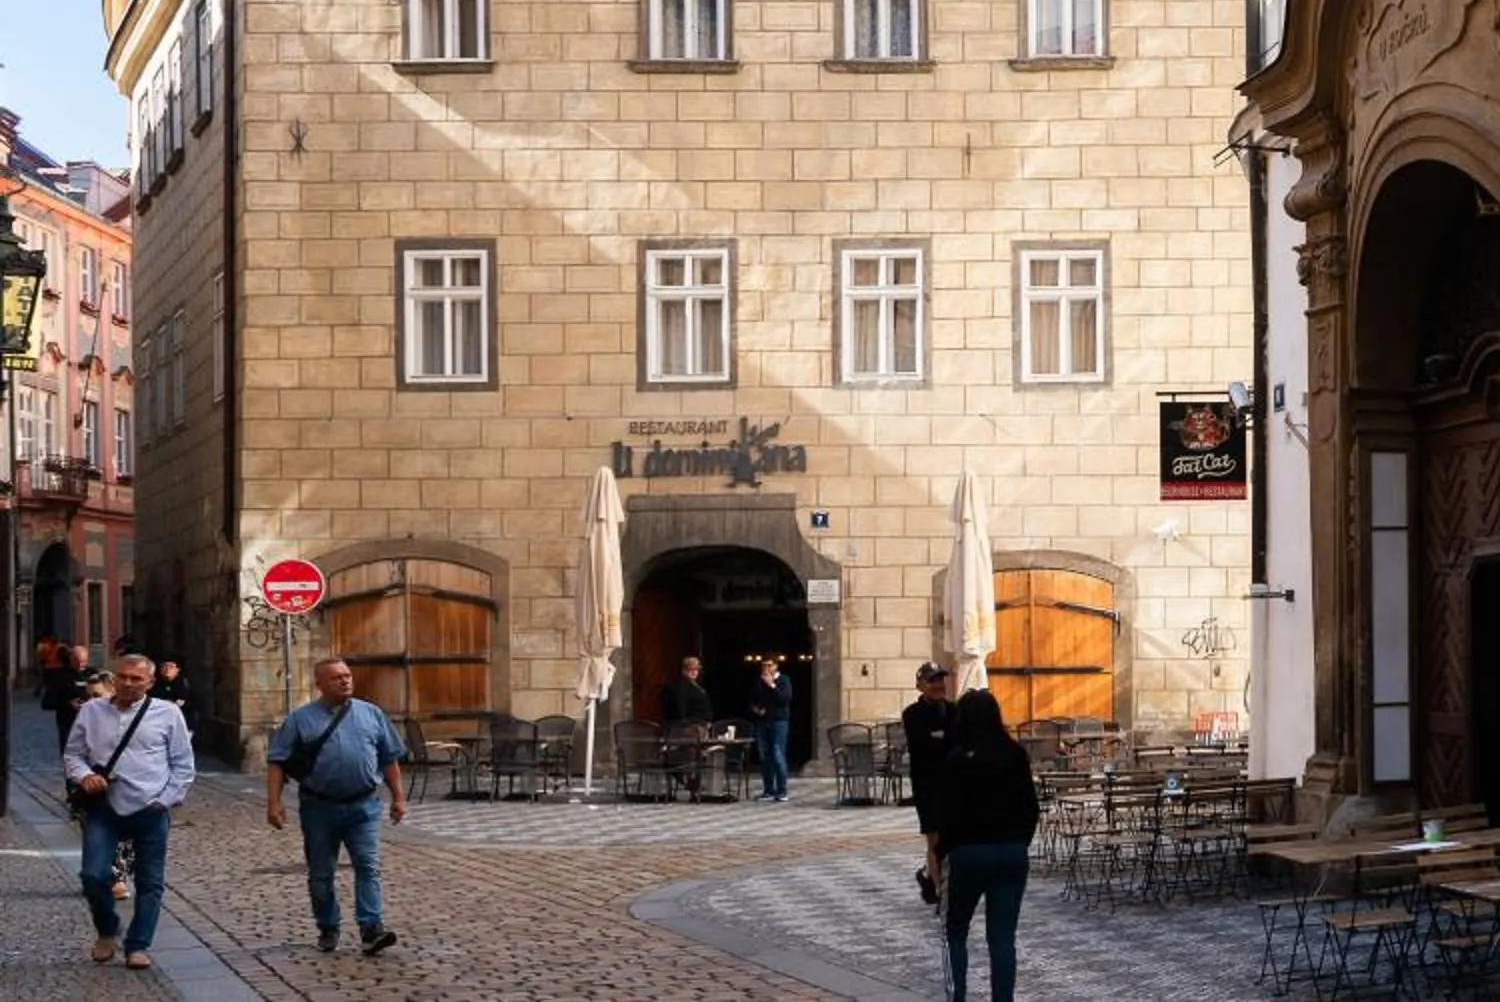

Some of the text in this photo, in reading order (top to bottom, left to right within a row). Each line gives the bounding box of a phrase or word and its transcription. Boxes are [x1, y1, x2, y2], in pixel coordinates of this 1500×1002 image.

[628, 419, 729, 435] RESTAURANT
[1172, 453, 1236, 477] Fat Cat
